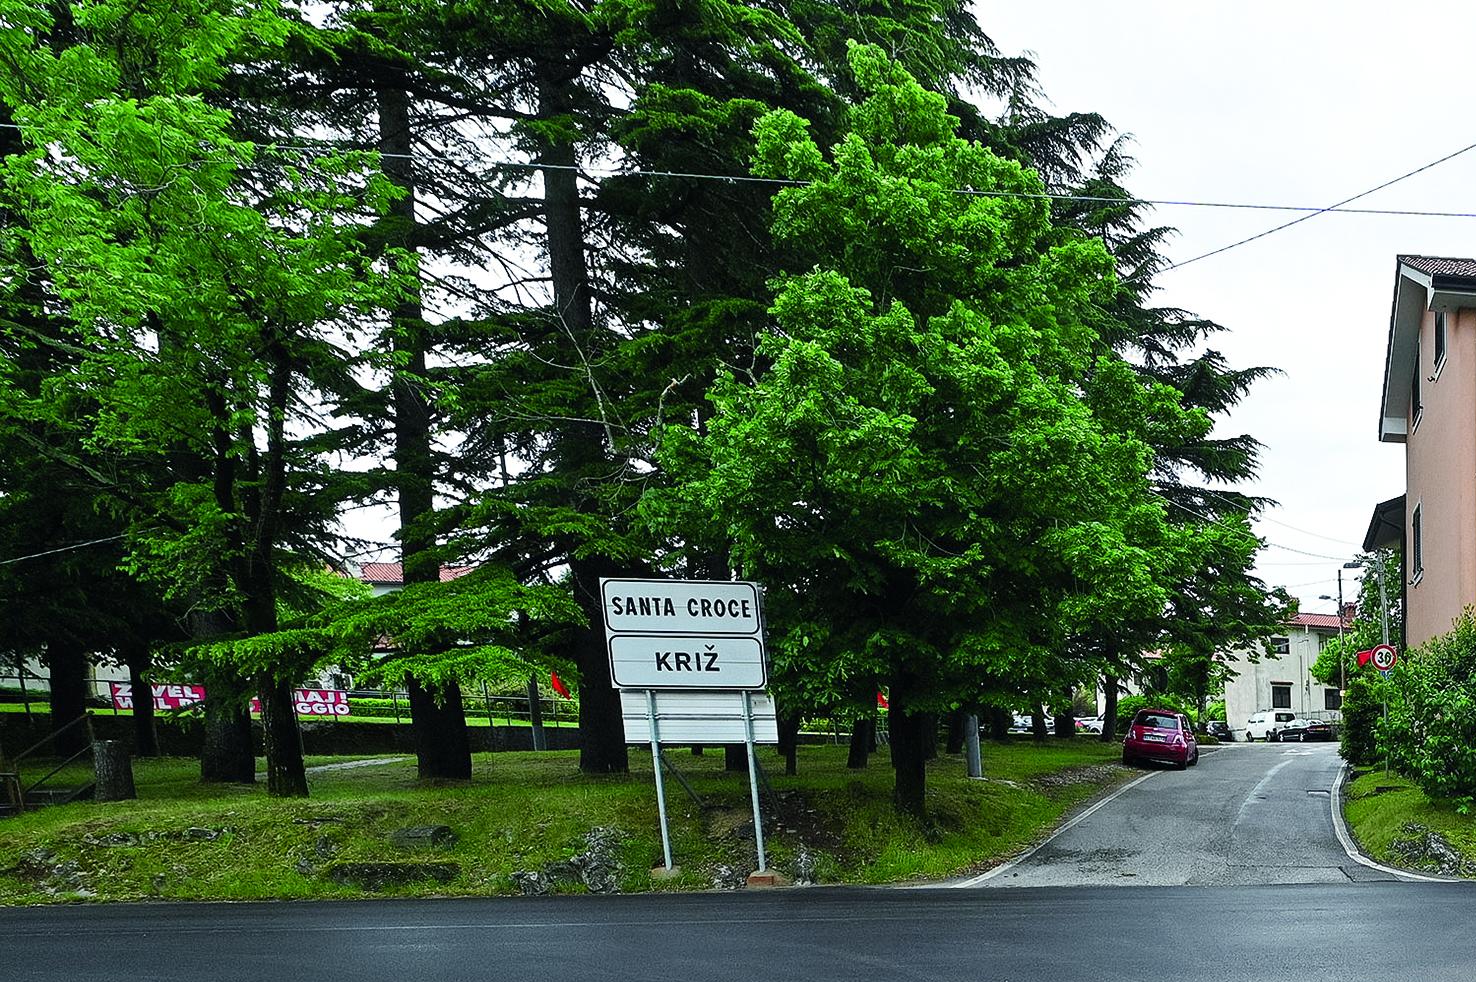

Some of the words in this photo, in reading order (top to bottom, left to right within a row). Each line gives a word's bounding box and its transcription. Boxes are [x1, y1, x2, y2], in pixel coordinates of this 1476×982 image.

[611, 596, 676, 617] SANTA
[687, 598, 752, 618] CROCE
[655, 644, 721, 672] KRIŽ
